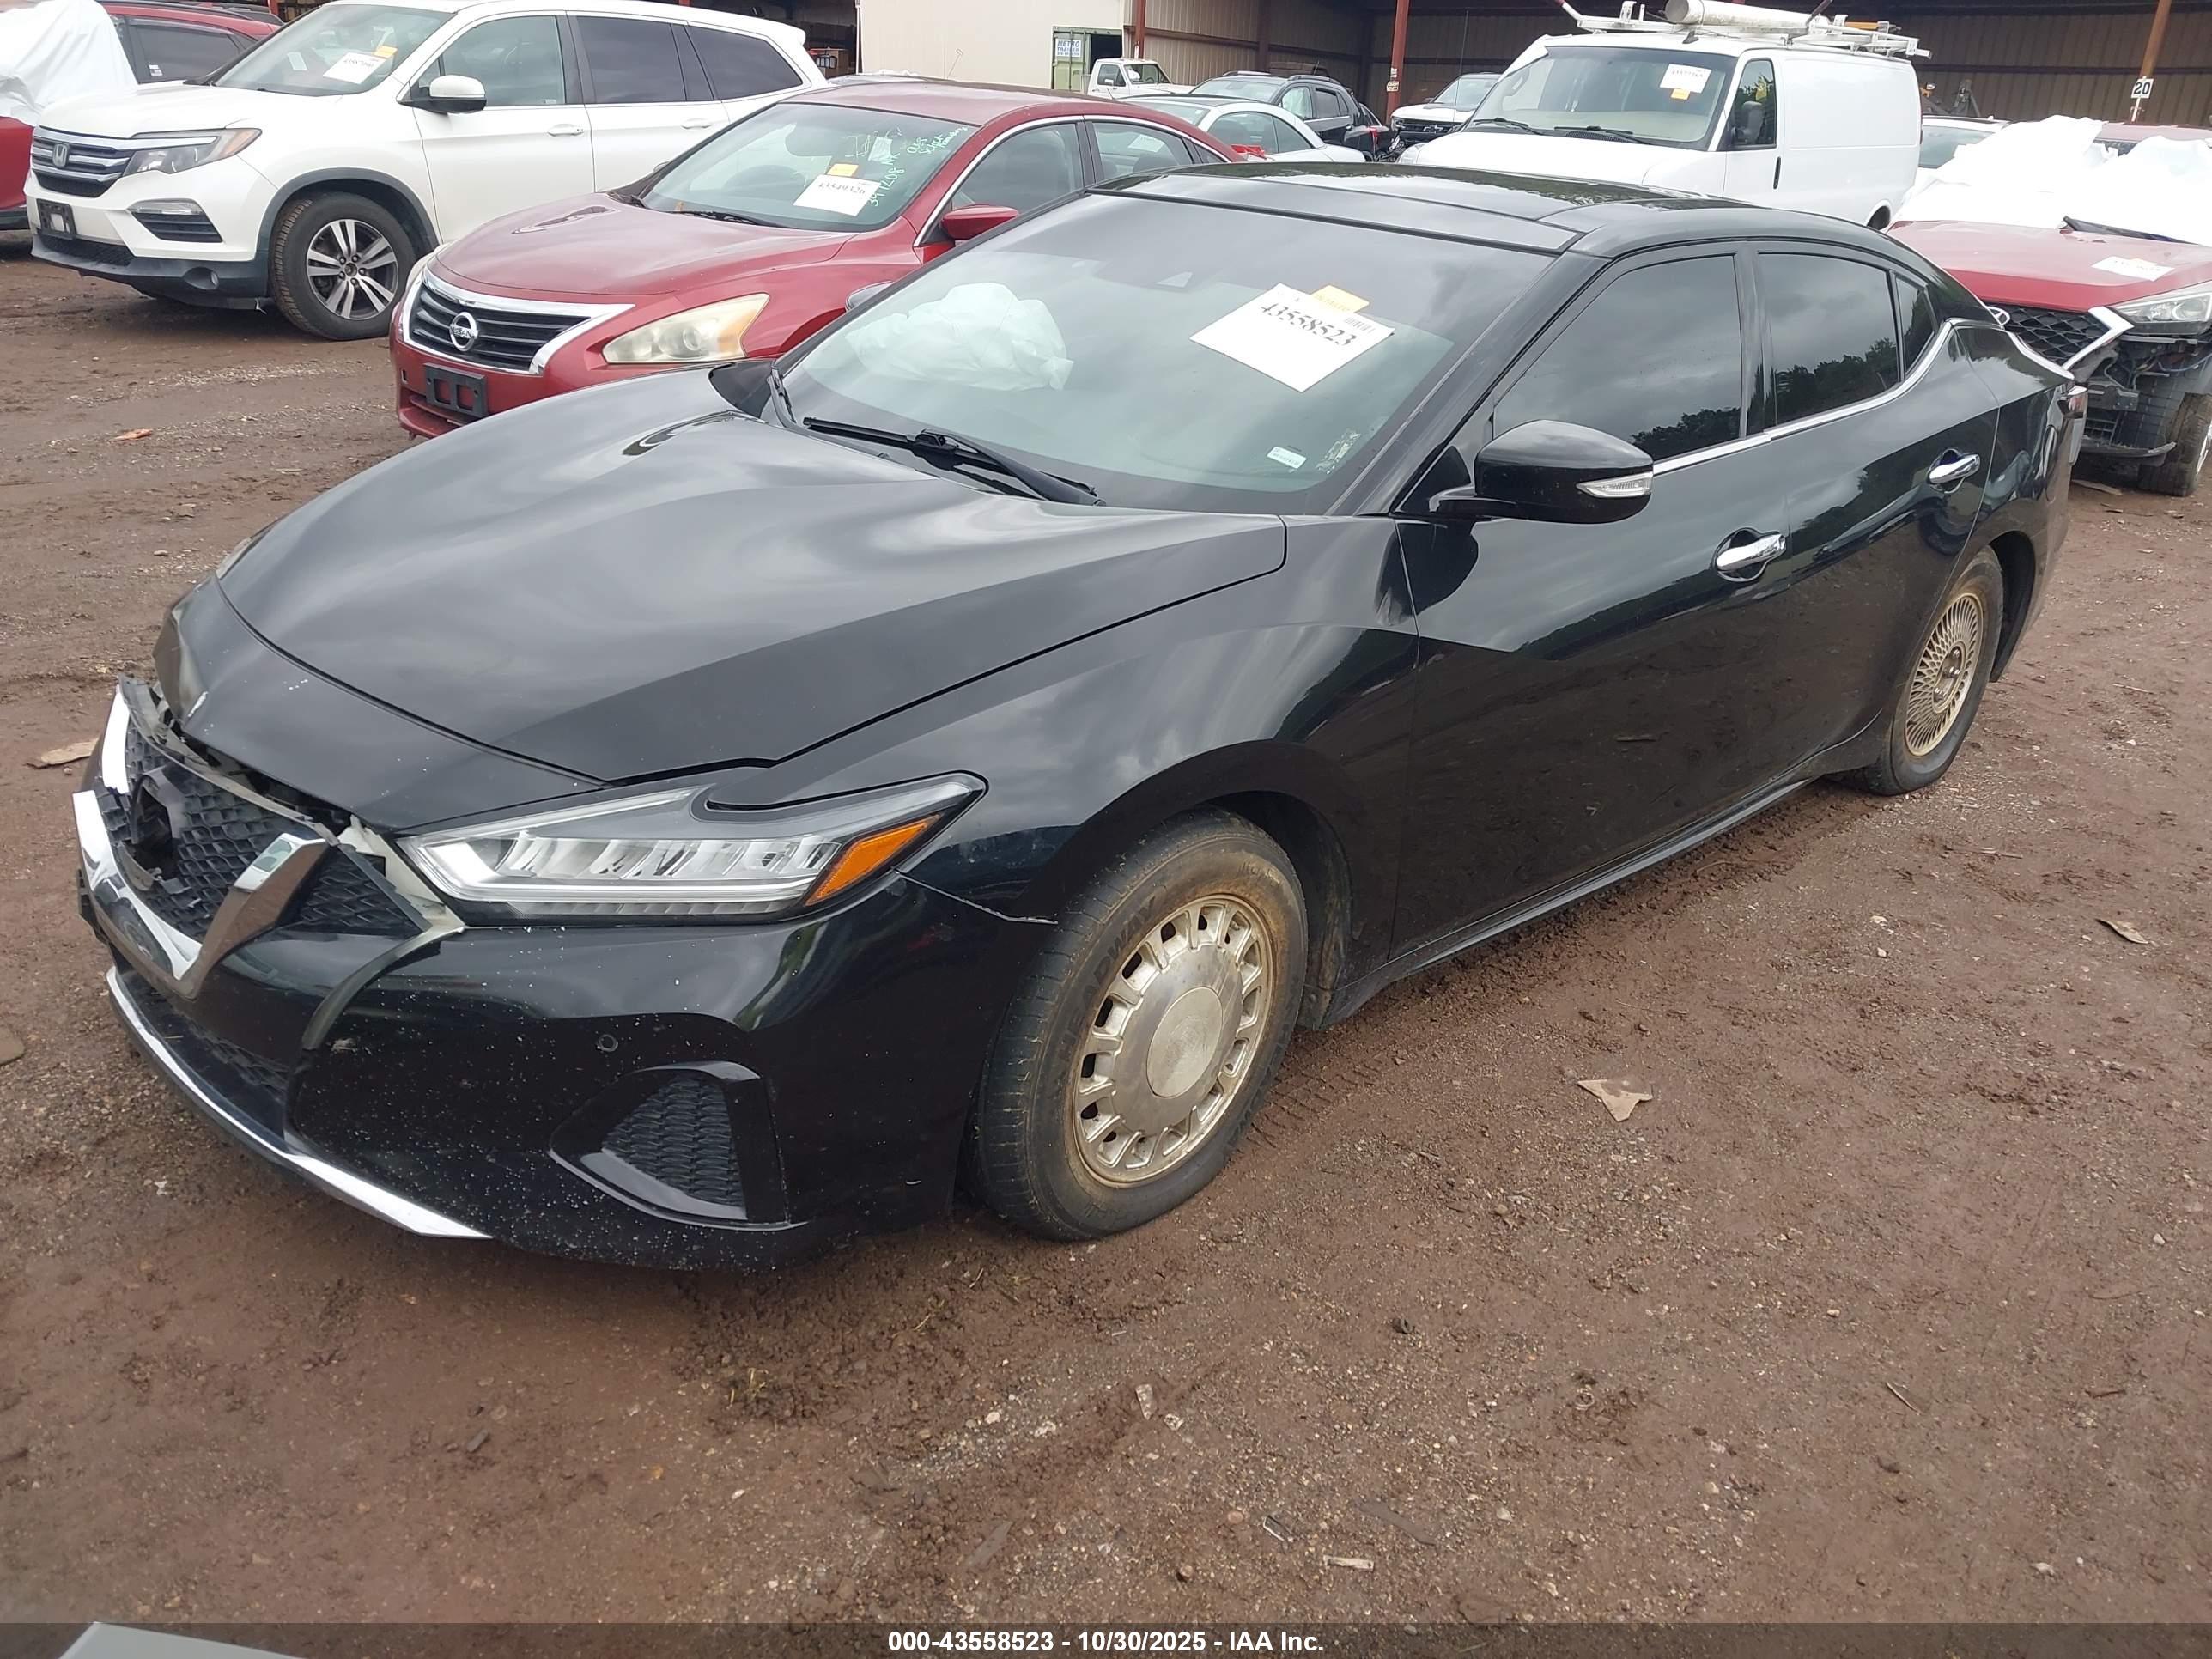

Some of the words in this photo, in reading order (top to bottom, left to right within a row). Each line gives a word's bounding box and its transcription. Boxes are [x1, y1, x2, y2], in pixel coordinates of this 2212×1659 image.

[2133, 82, 2151, 94] 20
[1259, 301, 1358, 347] 43558523
[450, 325, 472, 337] NISSAN
